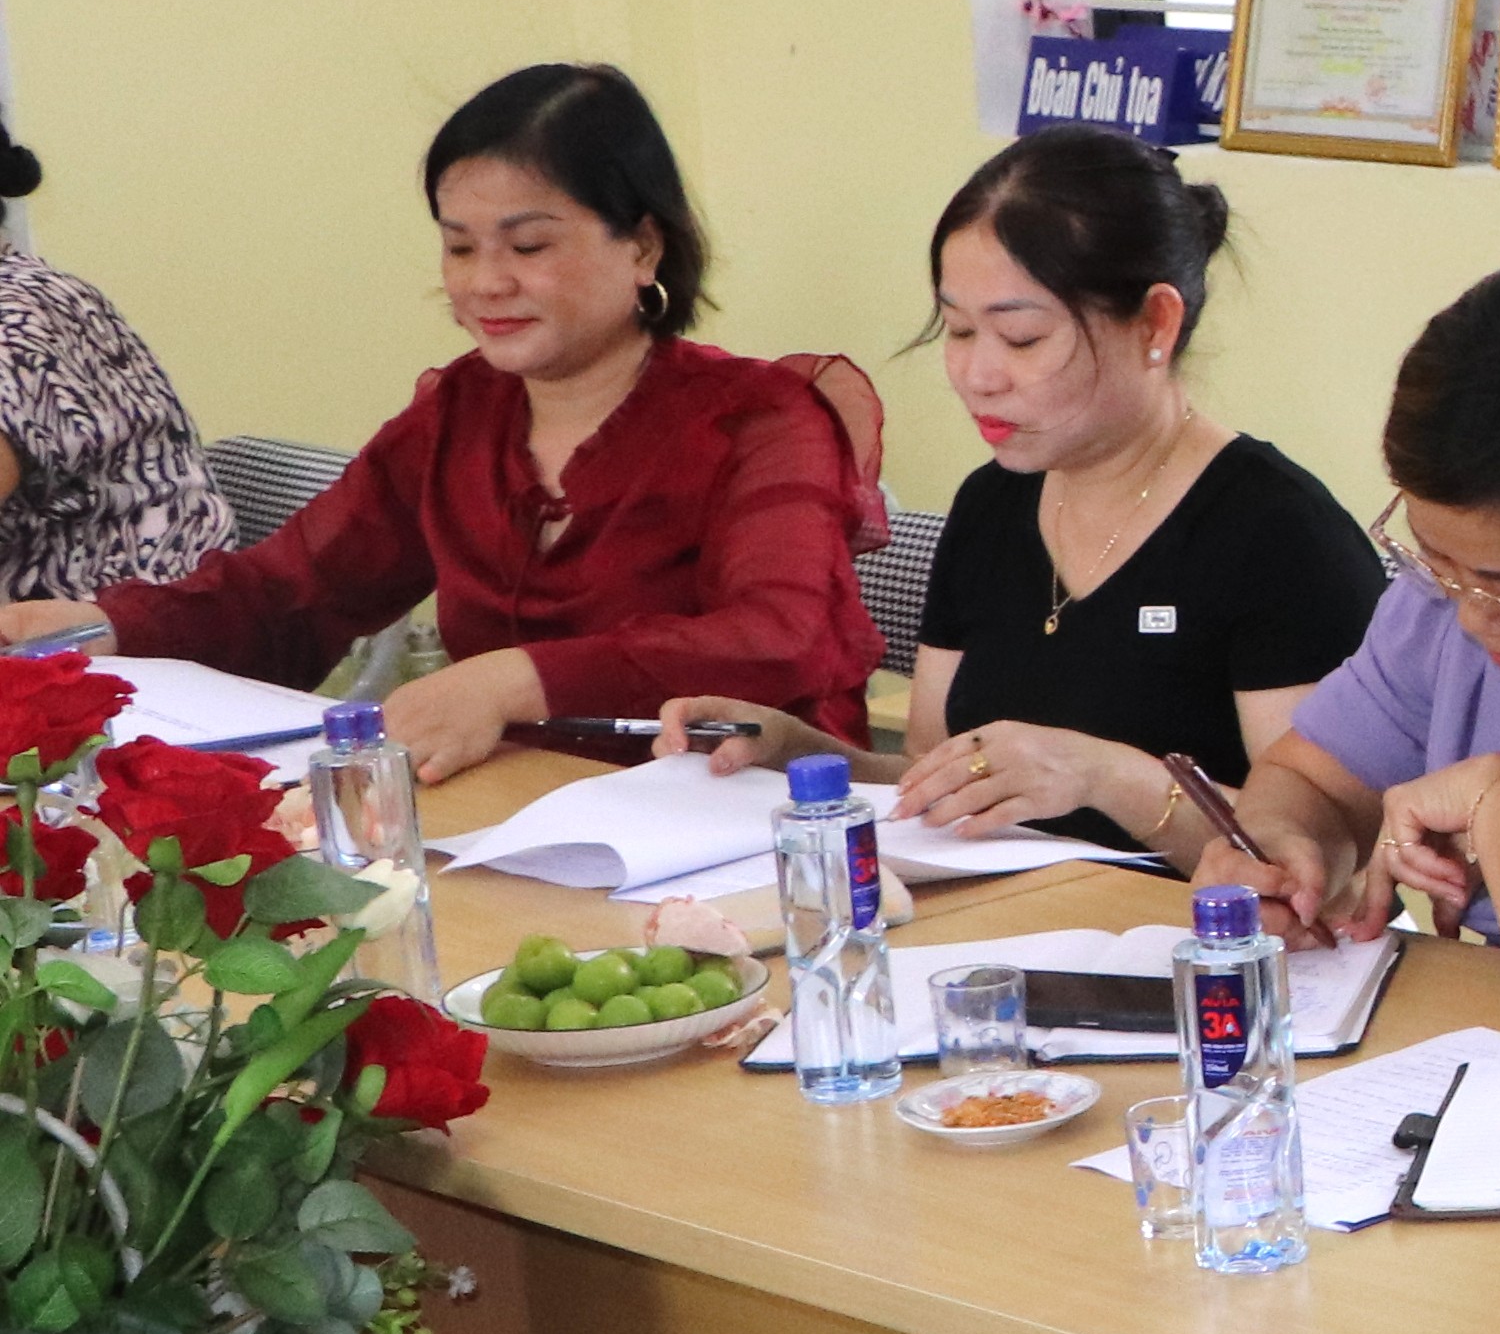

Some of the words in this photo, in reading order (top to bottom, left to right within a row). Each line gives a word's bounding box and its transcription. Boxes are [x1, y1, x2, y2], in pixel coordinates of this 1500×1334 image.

[1026, 55, 1082, 119] Đoàn
[1080, 55, 1125, 123] Chủ
[1124, 66, 1164, 135] tọa
[1203, 1011, 1243, 1040] 3A
